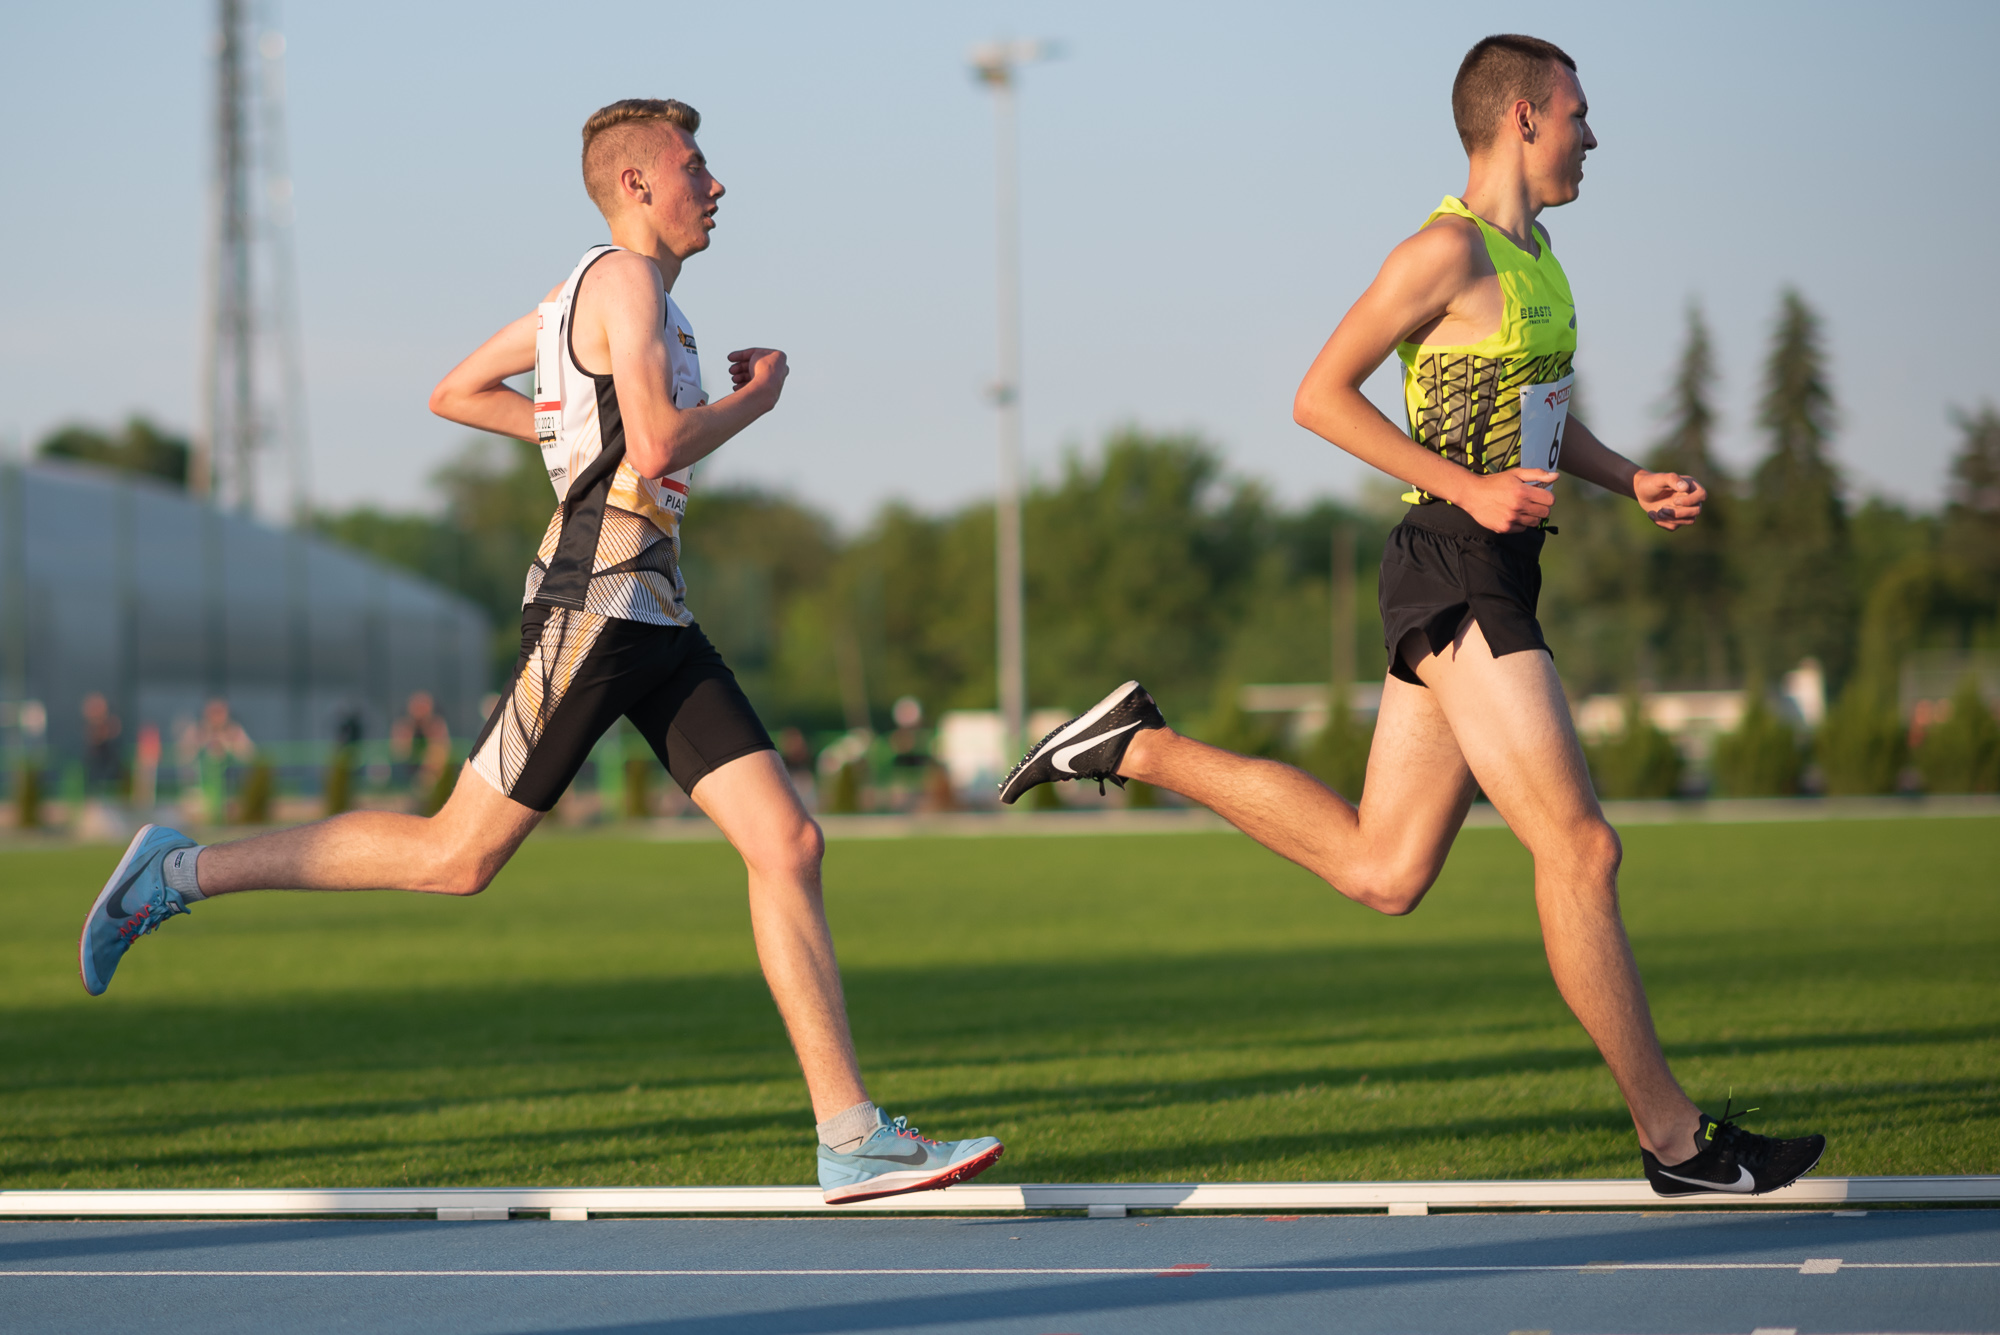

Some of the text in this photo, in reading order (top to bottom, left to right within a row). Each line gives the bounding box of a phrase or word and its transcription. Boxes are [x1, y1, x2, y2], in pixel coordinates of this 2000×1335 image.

[1520, 306, 1552, 319] BEASTS
[541, 416, 555, 430] 2021
[1548, 421, 1561, 469] 6
